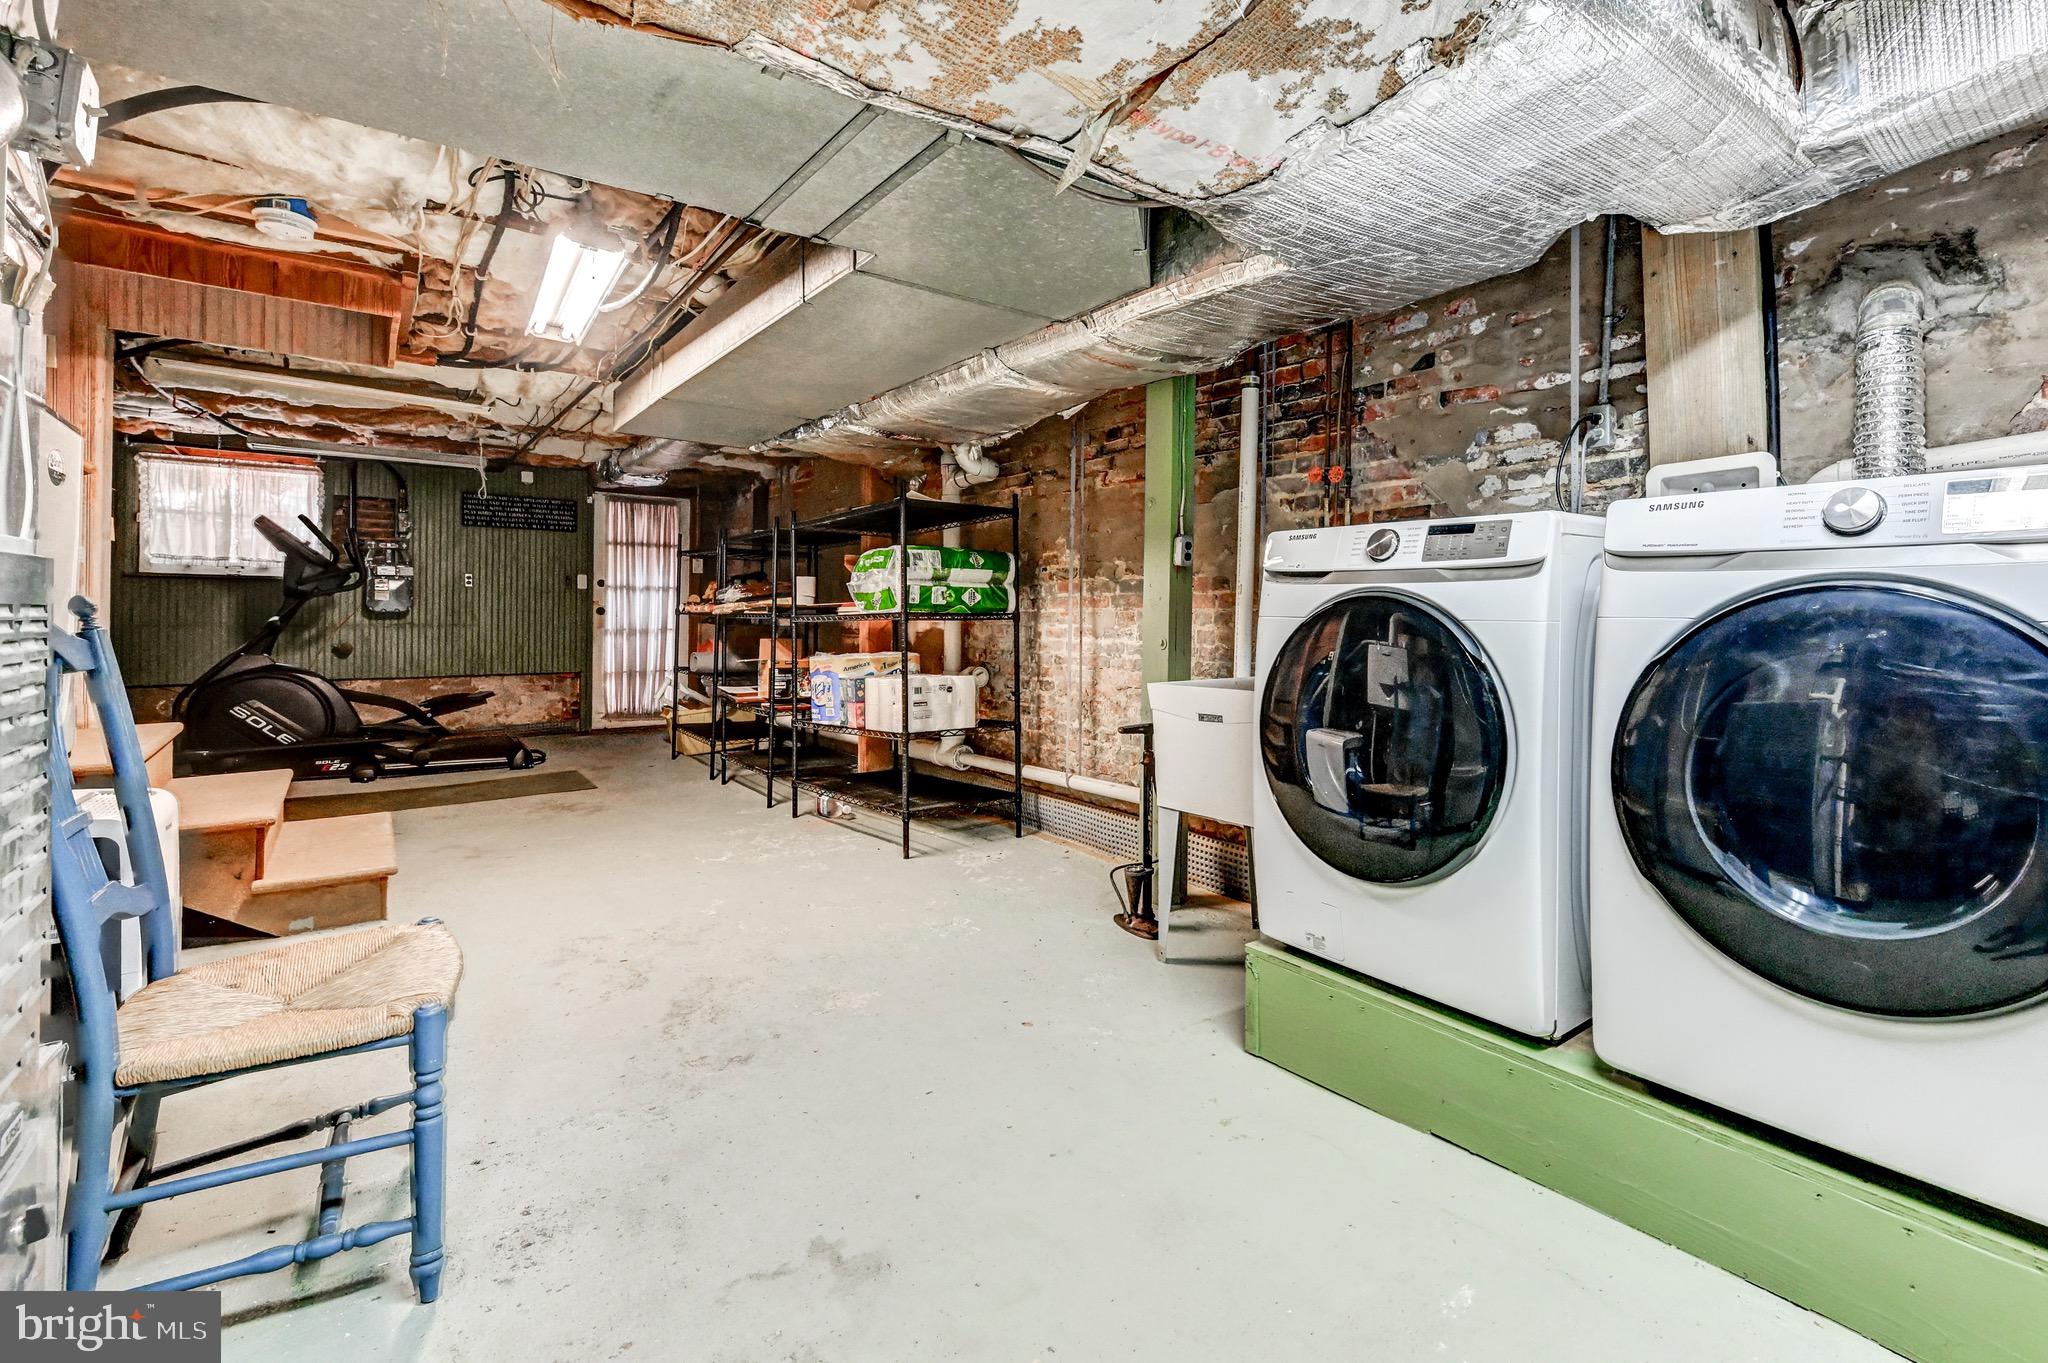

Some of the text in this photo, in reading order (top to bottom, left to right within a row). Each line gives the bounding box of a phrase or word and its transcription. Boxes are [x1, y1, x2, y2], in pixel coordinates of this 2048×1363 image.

[1648, 500, 1705, 512] SAMSUNG
[1288, 533, 1318, 541] SAMSUNG
[843, 661, 871, 671] America's
[229, 706, 297, 745] SOLE
